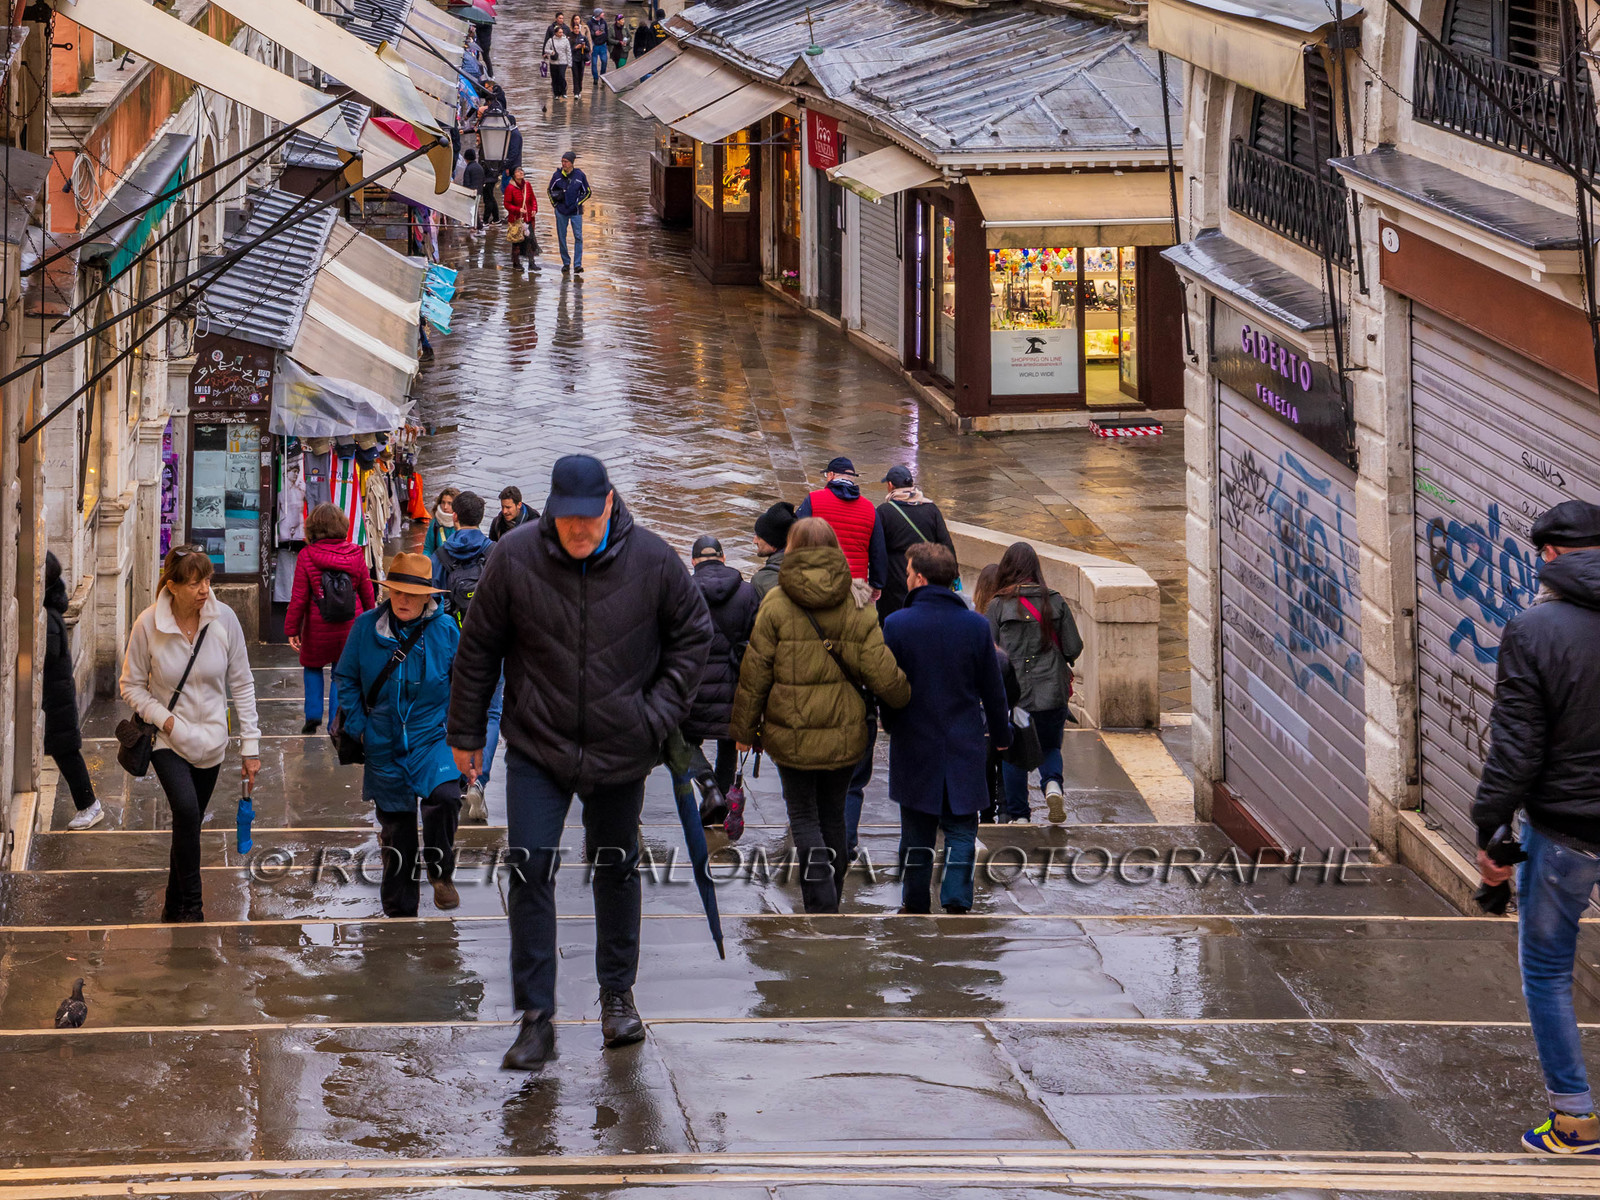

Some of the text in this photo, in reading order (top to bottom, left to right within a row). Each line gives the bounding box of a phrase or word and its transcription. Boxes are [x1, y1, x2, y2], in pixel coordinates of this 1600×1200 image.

[814, 140, 835, 158] VENEZIA
[1240, 324, 1312, 392] GIBERTO
[1256, 383, 1299, 424] VENEZIA
